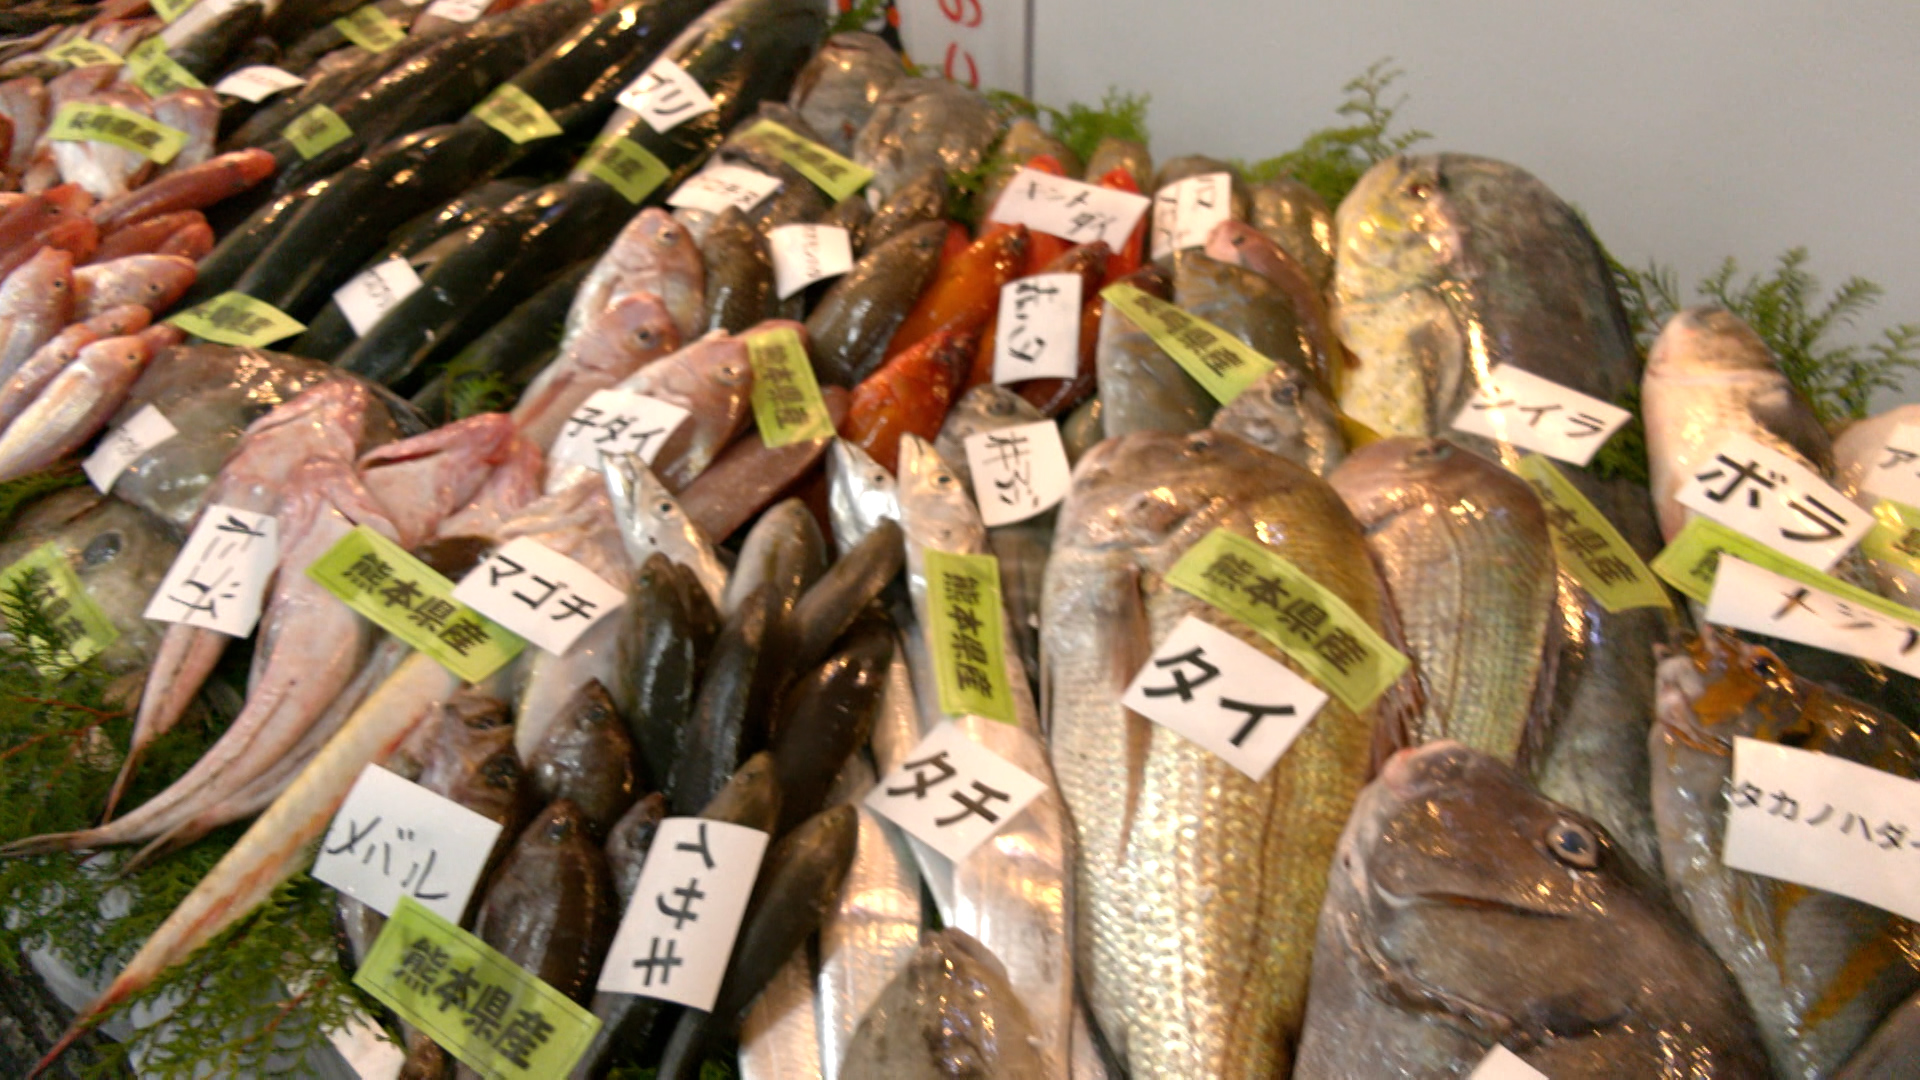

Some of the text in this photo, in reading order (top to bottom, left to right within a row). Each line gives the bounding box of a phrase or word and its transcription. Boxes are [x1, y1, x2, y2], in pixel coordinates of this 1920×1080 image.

[1695, 452, 1850, 543] ボラ
[342, 552, 492, 658] 熊本県産
[483, 553, 600, 625] マゴチ
[943, 570, 994, 700] 熊本県産
[1200, 552, 1369, 678] 熊本県産
[1142, 646, 1297, 748] タイ
[885, 750, 1012, 829] タチ
[1733, 779, 1920, 850] タカノハダ
[326, 815, 449, 901] メバル
[632, 822, 717, 989] イサキ
[392, 936, 555, 1071] 熊本県産
